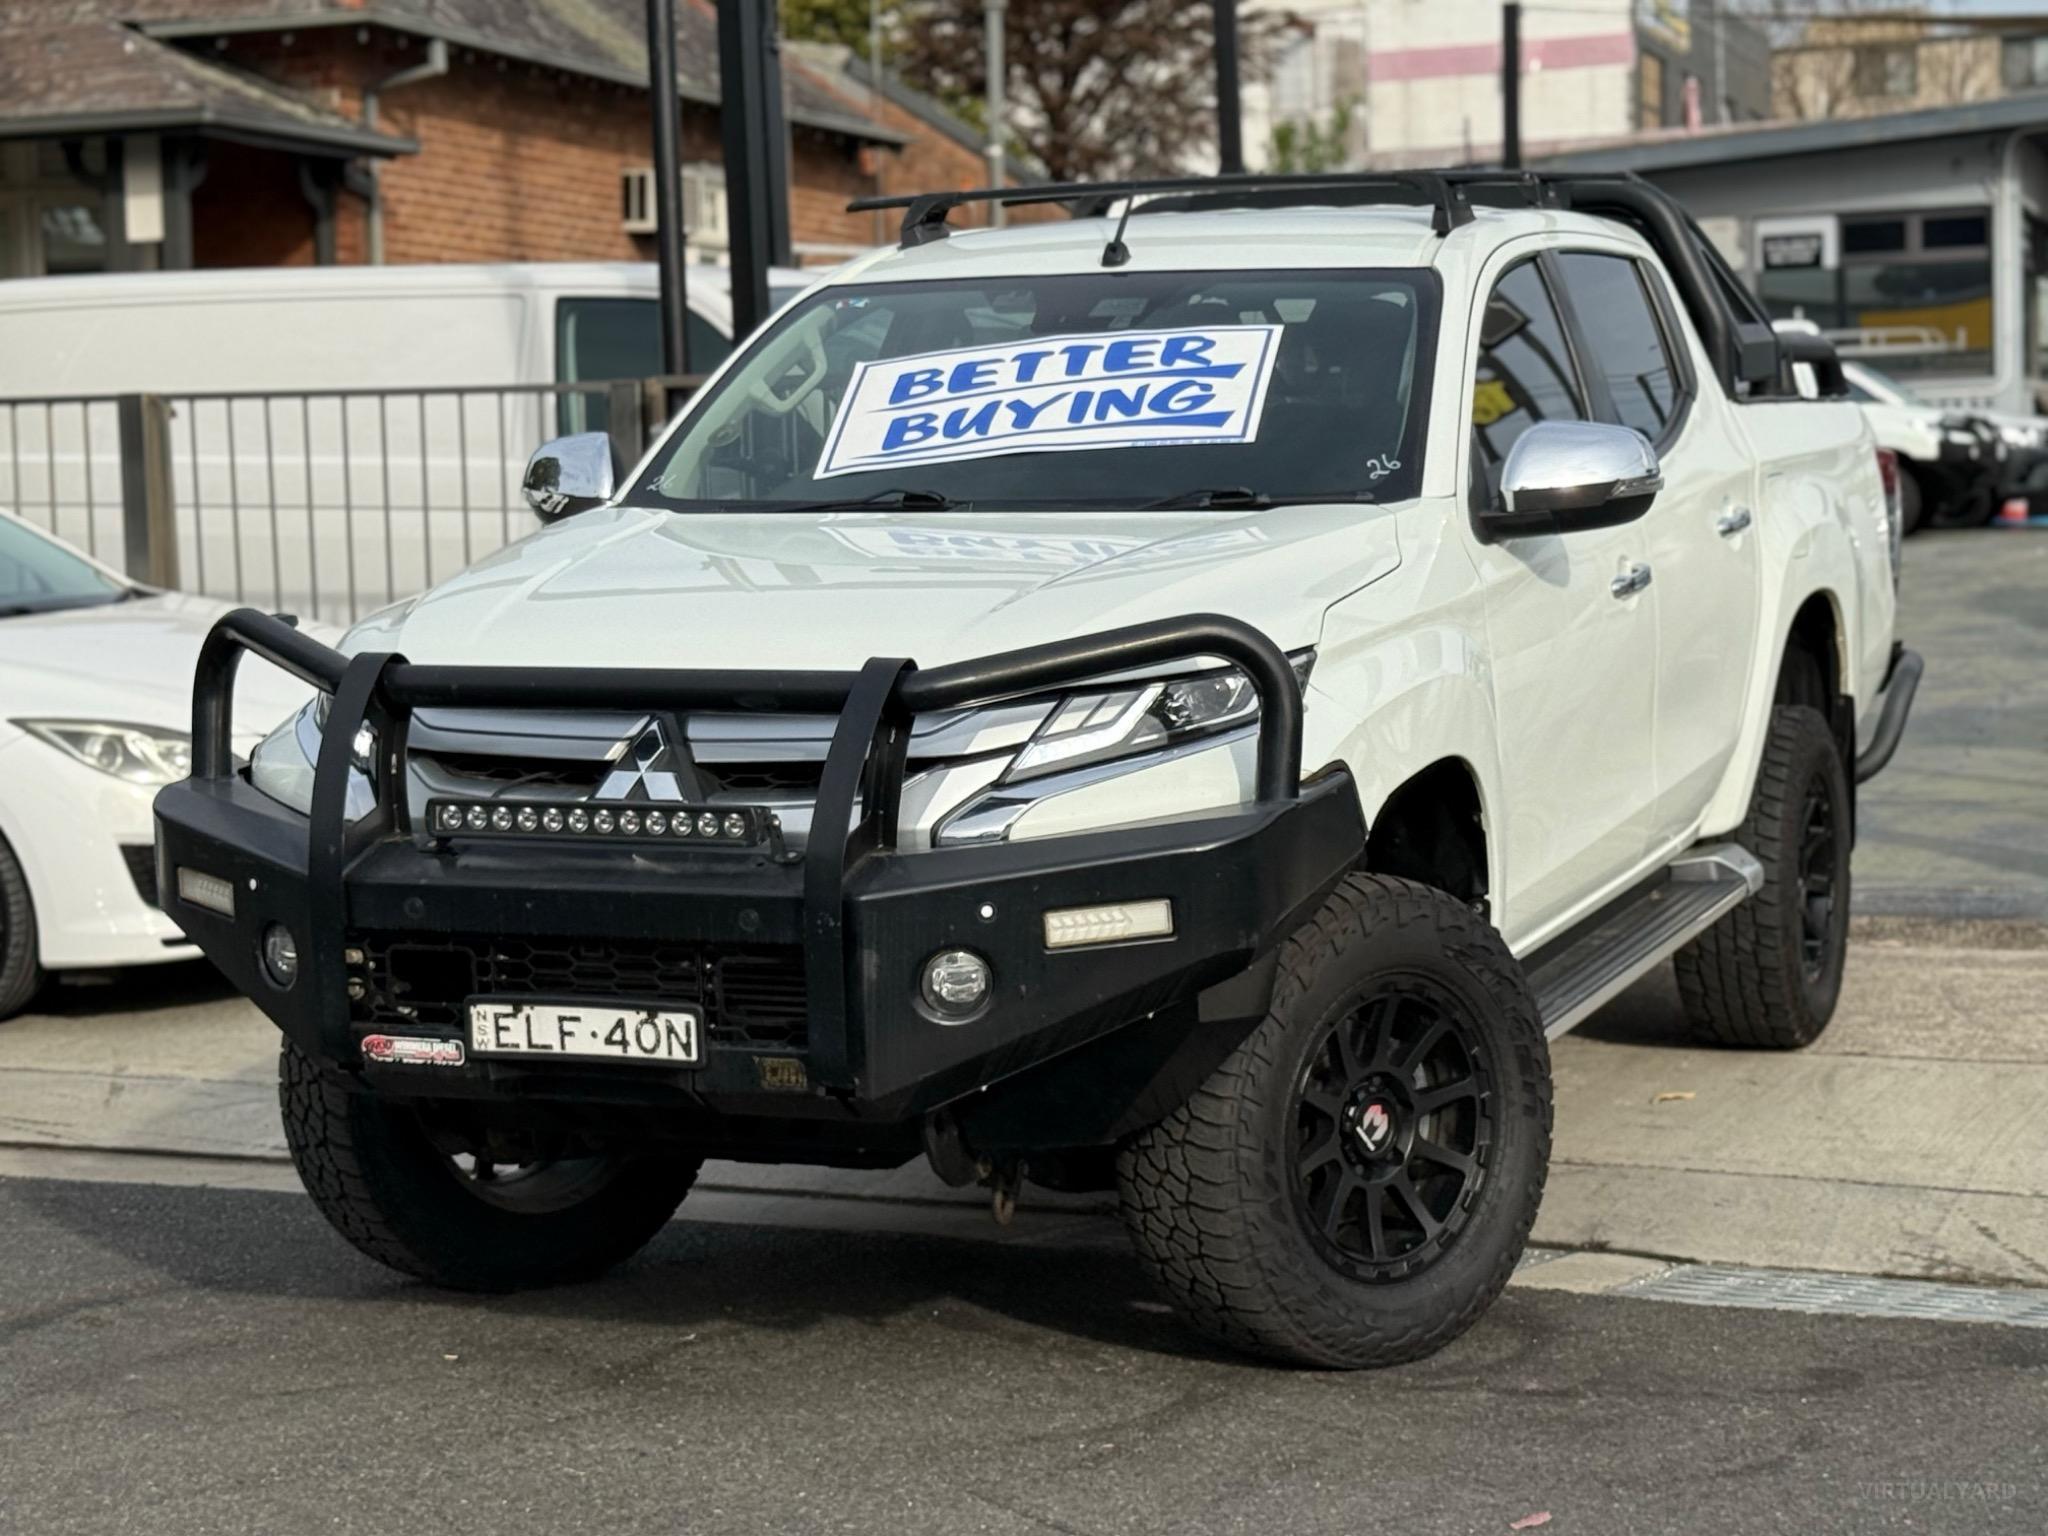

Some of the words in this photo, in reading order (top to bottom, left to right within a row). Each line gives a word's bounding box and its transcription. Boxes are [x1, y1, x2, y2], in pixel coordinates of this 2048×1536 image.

[888, 335, 1217, 406] BETTER
[881, 379, 1217, 451] BUYING
[1366, 453, 1401, 480] 26
[476, 1010, 489, 1049] NSW
